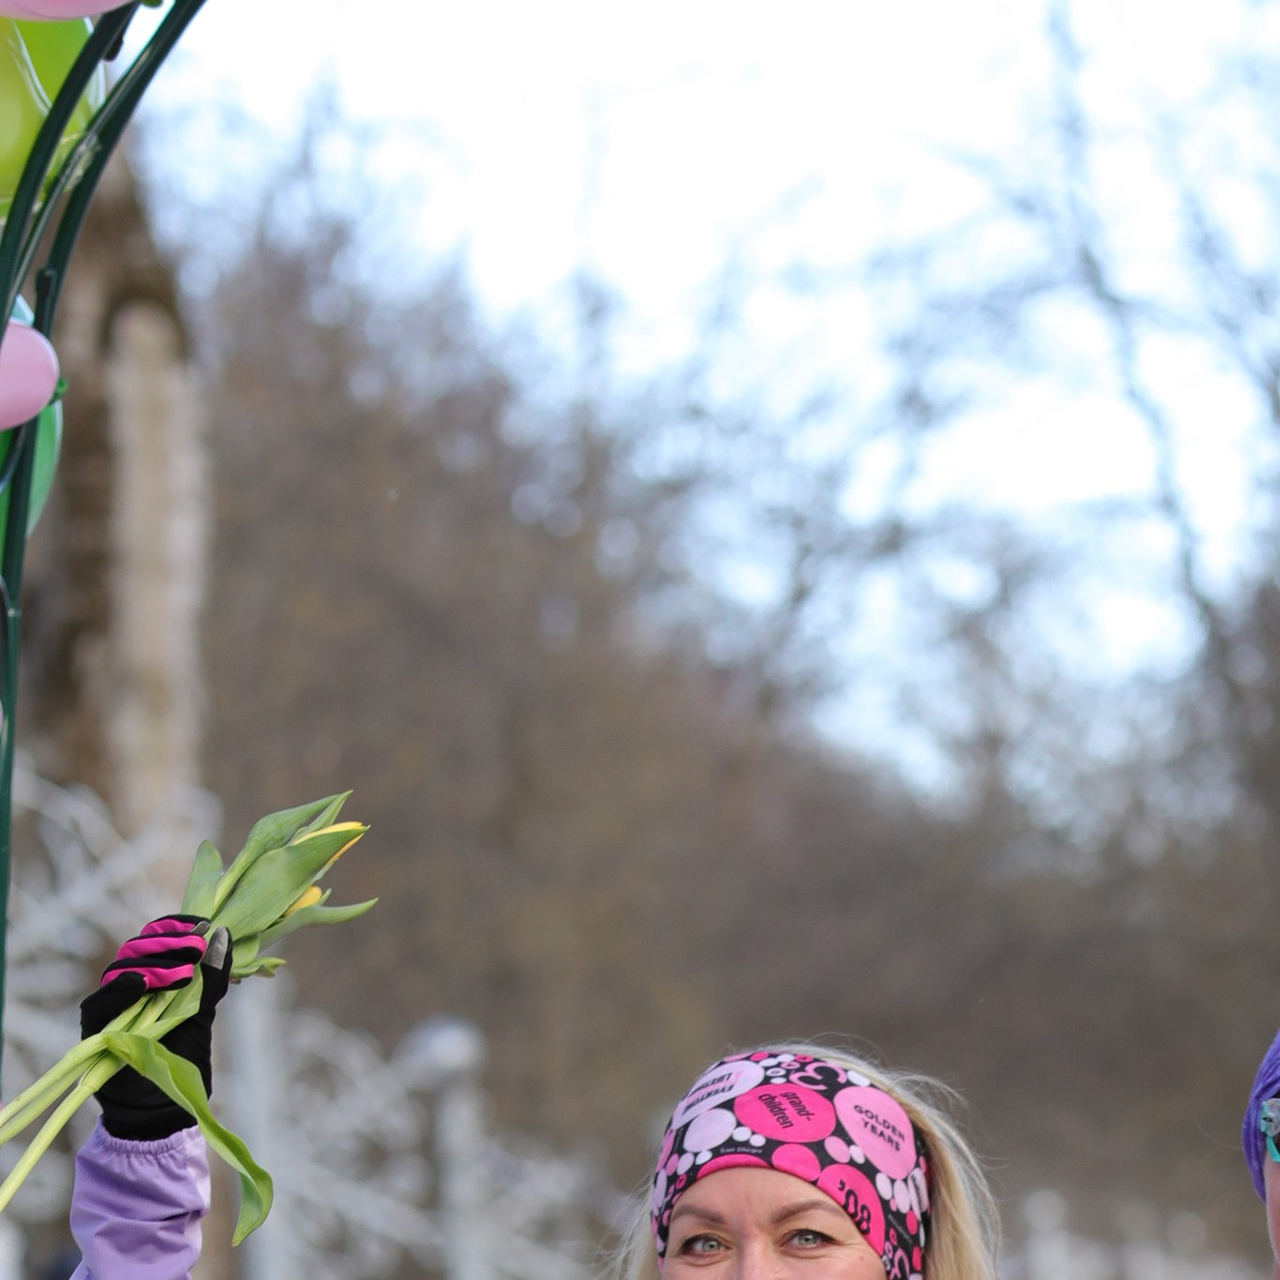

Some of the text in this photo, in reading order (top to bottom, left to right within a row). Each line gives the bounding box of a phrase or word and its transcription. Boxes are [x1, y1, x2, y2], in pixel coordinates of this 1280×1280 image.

[758, 1093, 795, 1130] children
[780, 1091, 811, 1122] grand-
[854, 1104, 906, 1142] GOLDEN
[862, 1118, 901, 1151] YEARS
